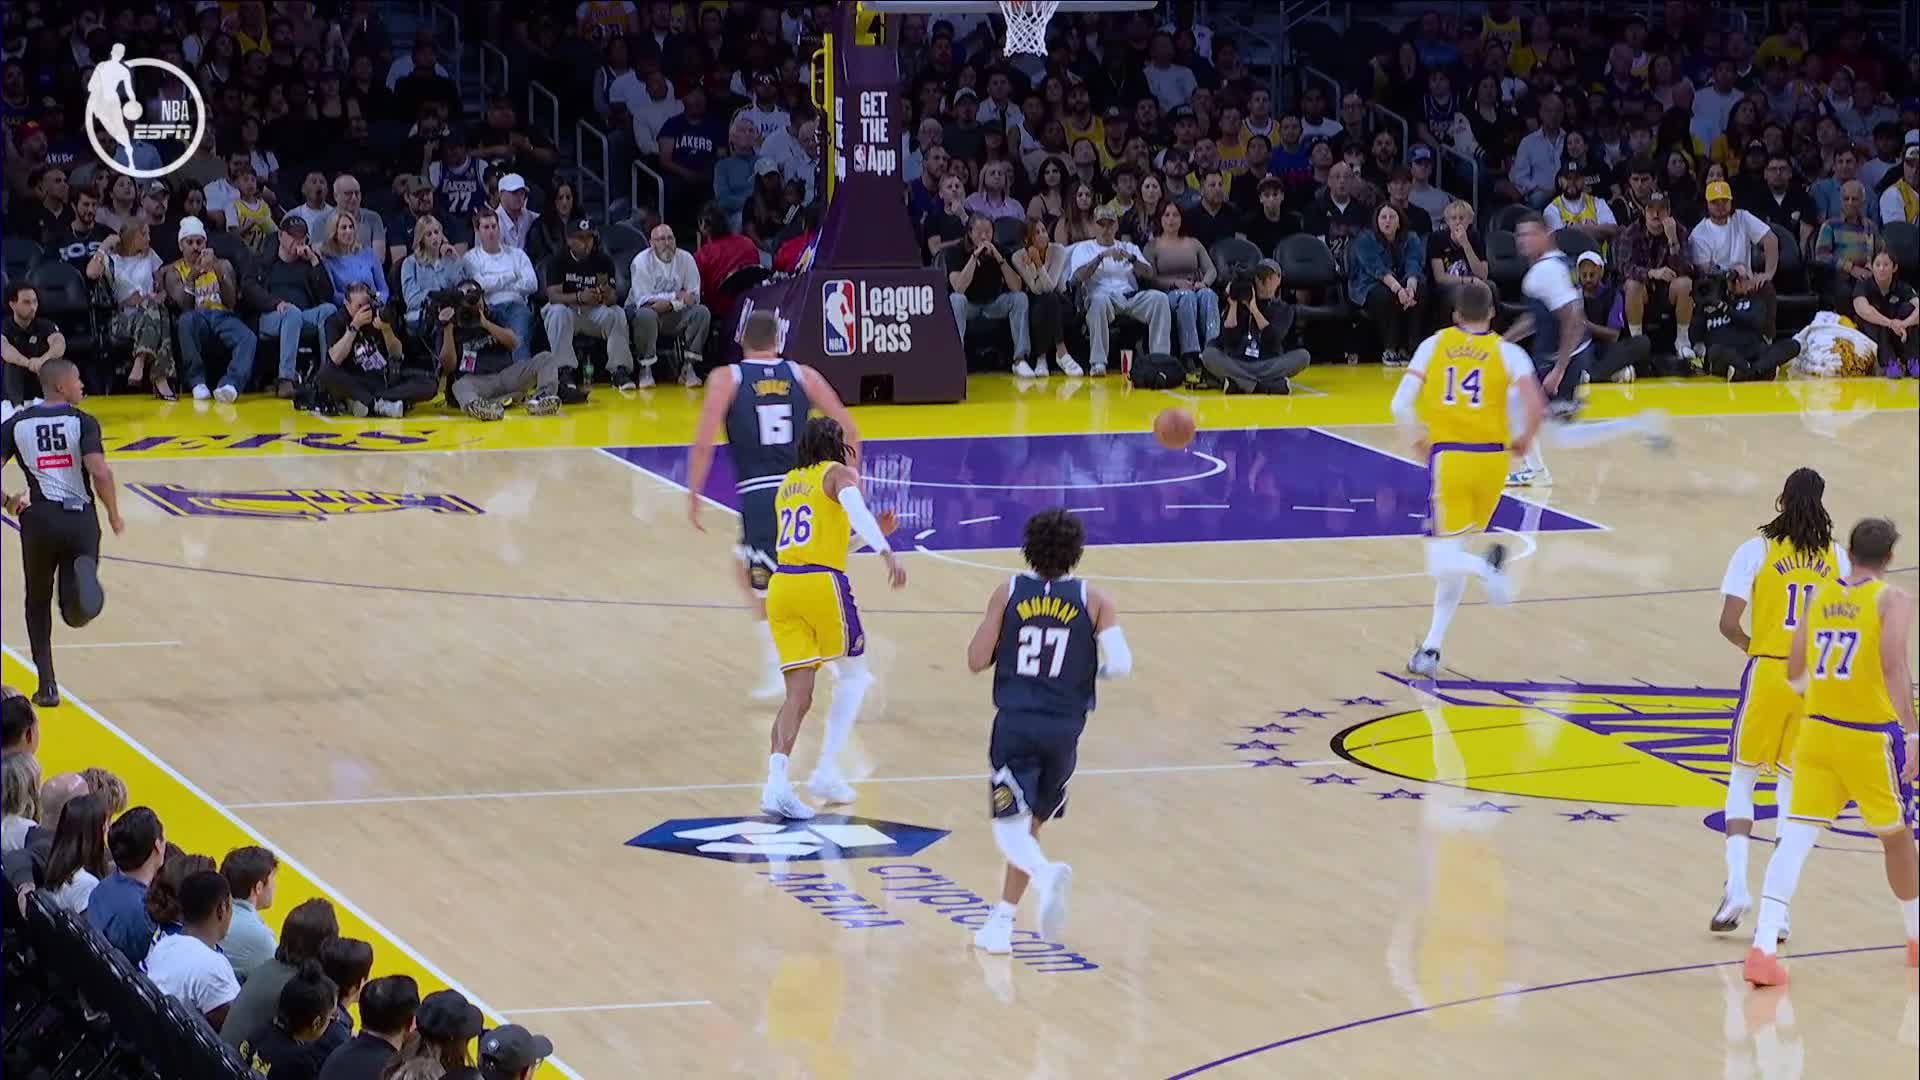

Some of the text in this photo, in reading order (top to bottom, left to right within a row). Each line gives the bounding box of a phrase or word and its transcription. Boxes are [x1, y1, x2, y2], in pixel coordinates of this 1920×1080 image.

[860, 91, 888, 117] GET
[675, 135, 713, 153] LAKERS
[860, 118, 889, 143] THE
[867, 144, 896, 176] App
[449, 191, 472, 213] 77
[860, 280, 934, 322] League
[829, 338, 845, 351] NBA
[861, 318, 912, 354] Pass
[1442, 366, 1482, 407] 14
[36, 423, 67, 452] 85
[778, 503, 813, 549] 26
[1773, 550, 1832, 578] WILLIAMS
[1016, 596, 1080, 624] MURRAY
[1016, 625, 1071, 678] 27
[1813, 628, 1861, 681] 77
[755, 870, 905, 929] ARENA
